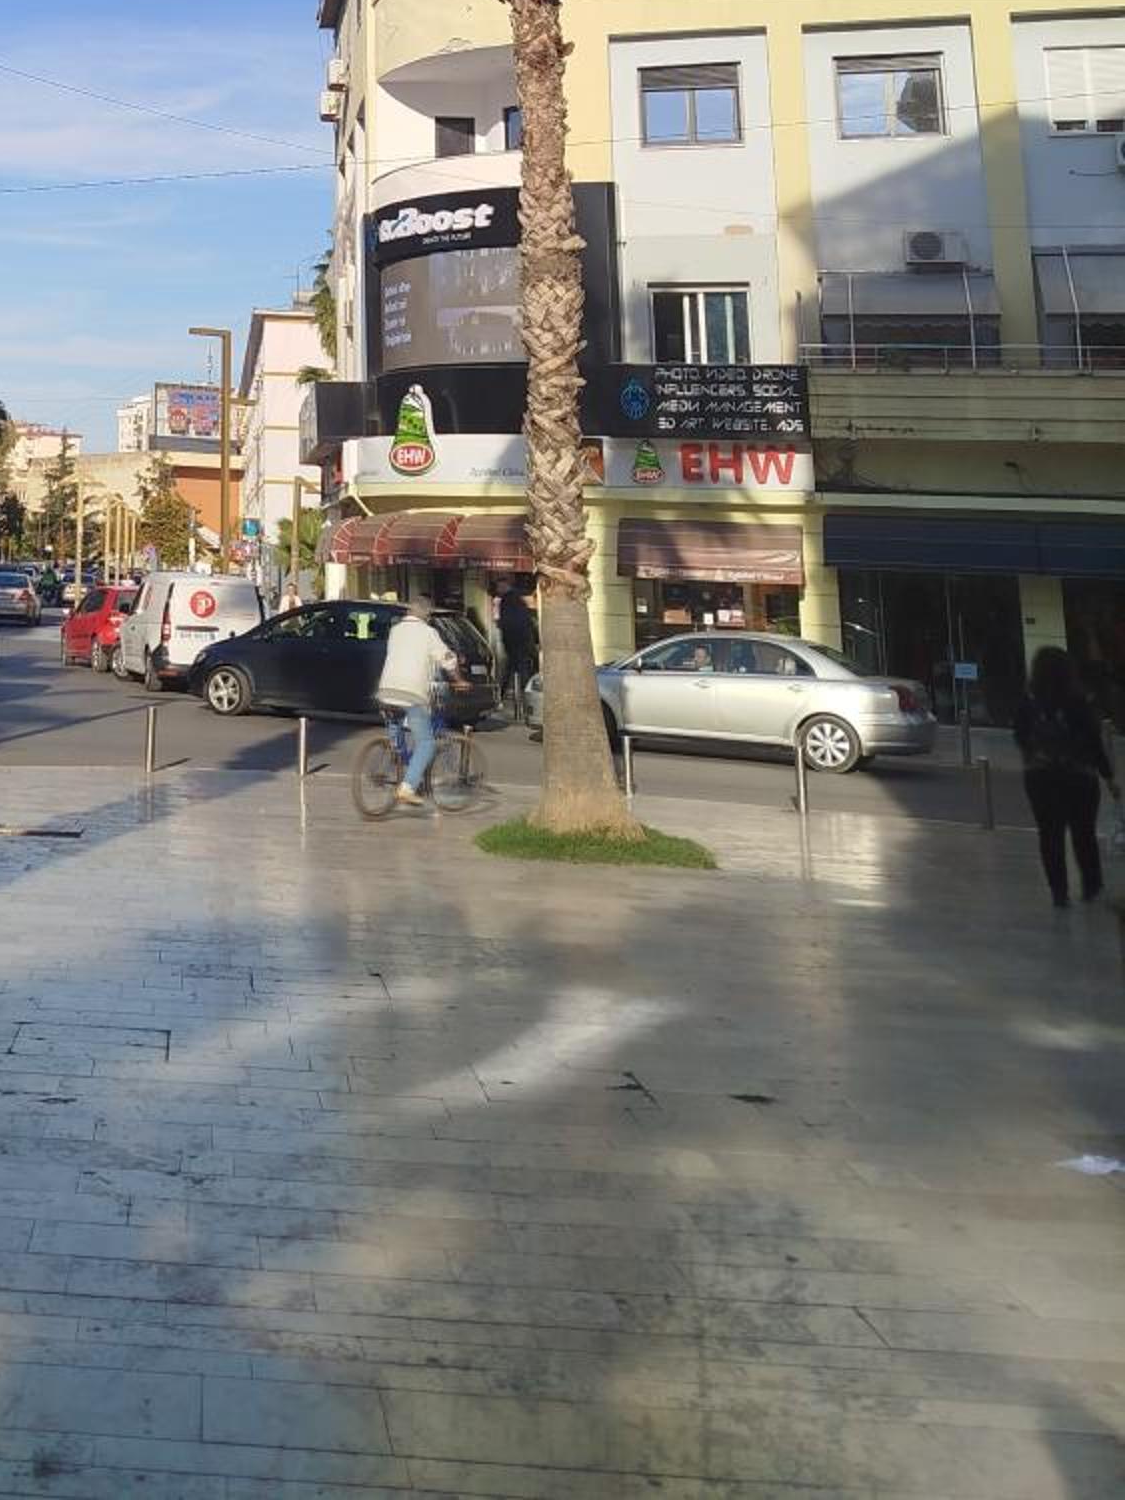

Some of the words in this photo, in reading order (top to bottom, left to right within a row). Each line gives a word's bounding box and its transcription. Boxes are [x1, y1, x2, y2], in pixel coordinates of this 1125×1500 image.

[752, 384, 800, 398] SOCIAL
[705, 400, 802, 414] MANAGEMENT
[396, 449, 426, 465] EHW
[681, 442, 795, 485] EHW
